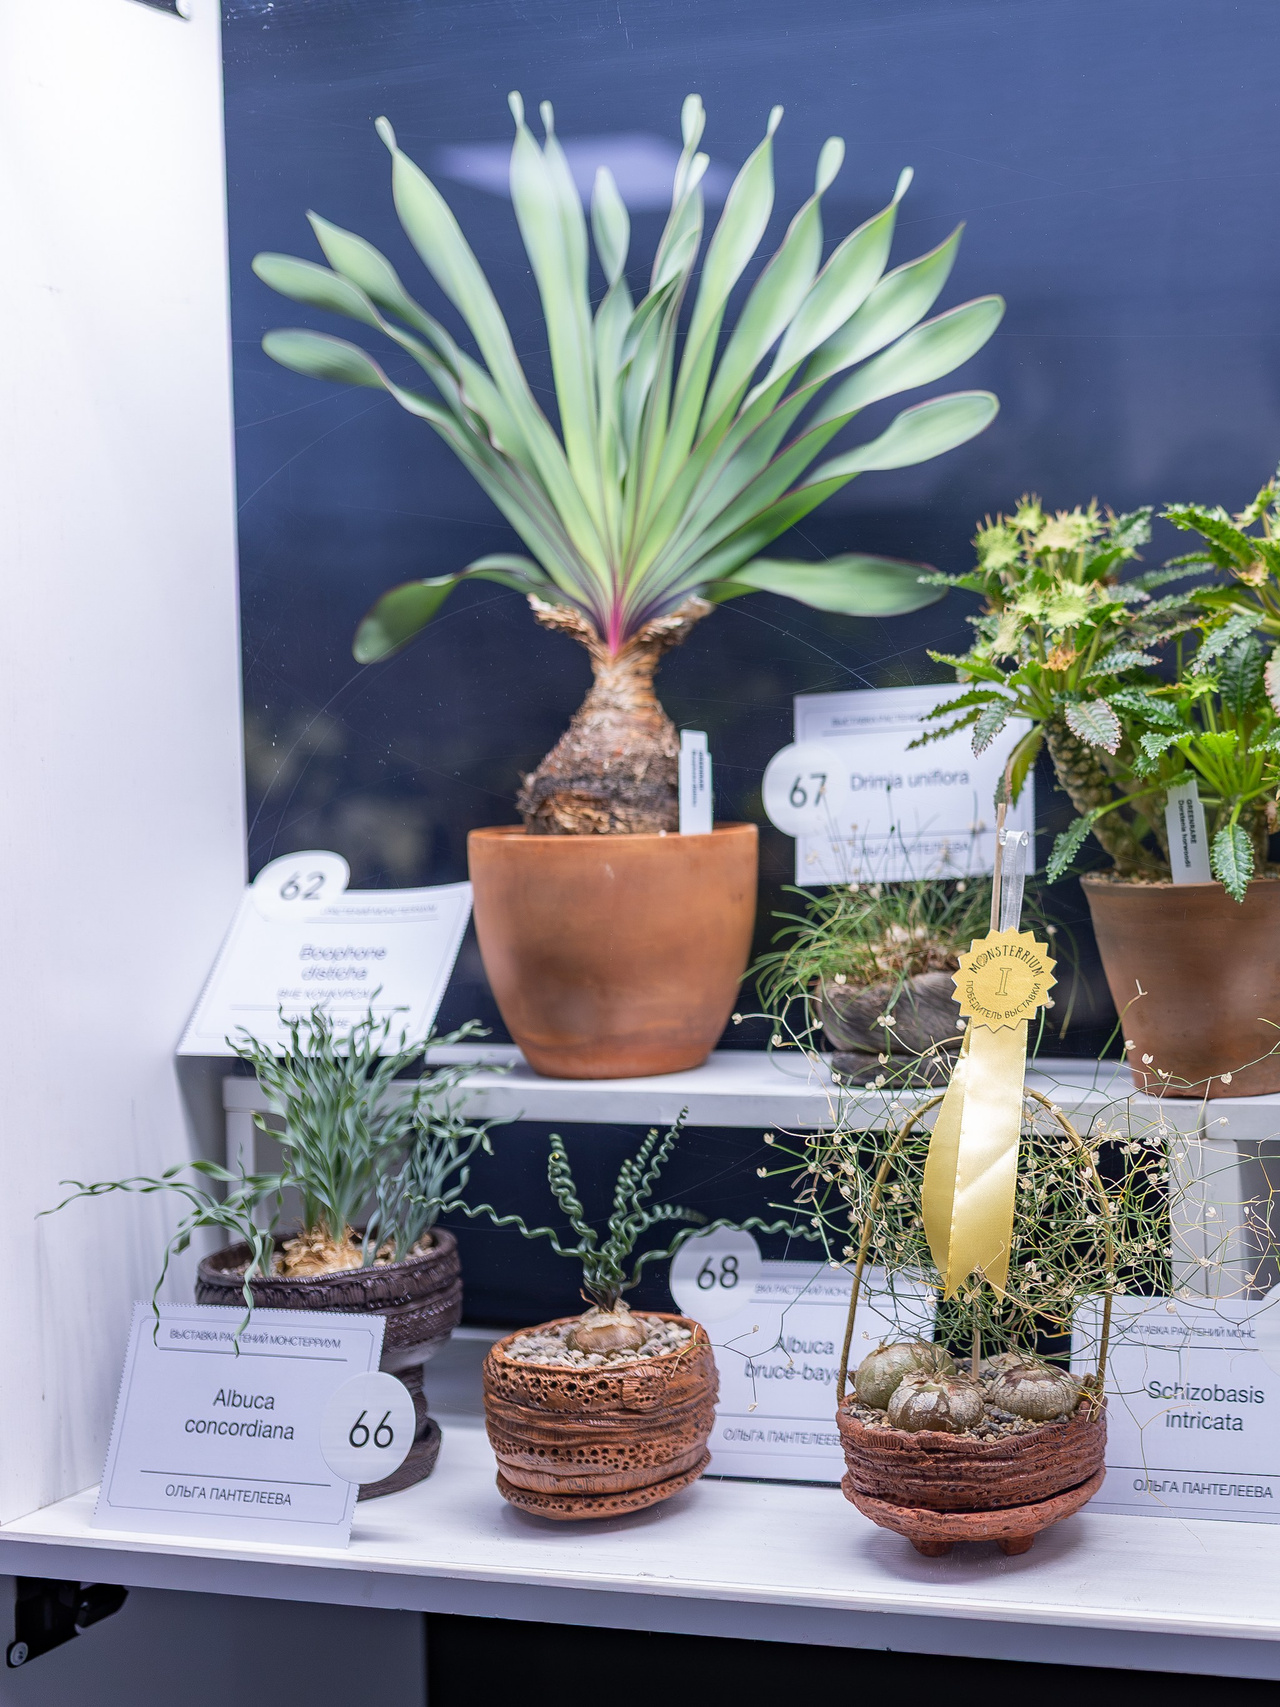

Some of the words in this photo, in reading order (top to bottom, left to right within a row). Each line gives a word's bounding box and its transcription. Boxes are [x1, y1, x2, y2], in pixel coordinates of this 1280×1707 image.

[789, 773, 827, 808] 67
[850, 771, 902, 792] Drimia
[907, 771, 969, 789] uniflora
[1186, 799, 1197, 844] GREENRARE
[279, 872, 326, 900] 62
[965, 979, 1003, 1020] ПОБЕДИТЕЛЬ
[1003, 982, 1042, 1019] ВЫСТАВКИ
[696, 1254, 739, 1290] 68
[169, 1328, 216, 1341] ВЫСТАВКА
[269, 1336, 341, 1349] МОНСТЕРРИУМ
[773, 1335, 834, 1355] Albuca
[212, 1388, 275, 1410] Albuca
[1148, 1381, 1265, 1404] Schizobasis
[184, 1418, 295, 1441] concordiana
[348, 1410, 394, 1449] 66
[1166, 1411, 1243, 1431] intricata
[722, 1428, 765, 1442] ОЛЬГА
[165, 1484, 206, 1499] ОЛЬГА
[209, 1487, 291, 1506] ПАНТЕЛЕЕВА
[1133, 1479, 1179, 1494] ОЛЬГА
[1182, 1482, 1273, 1499] ПАНТЕЛЕЕВА
